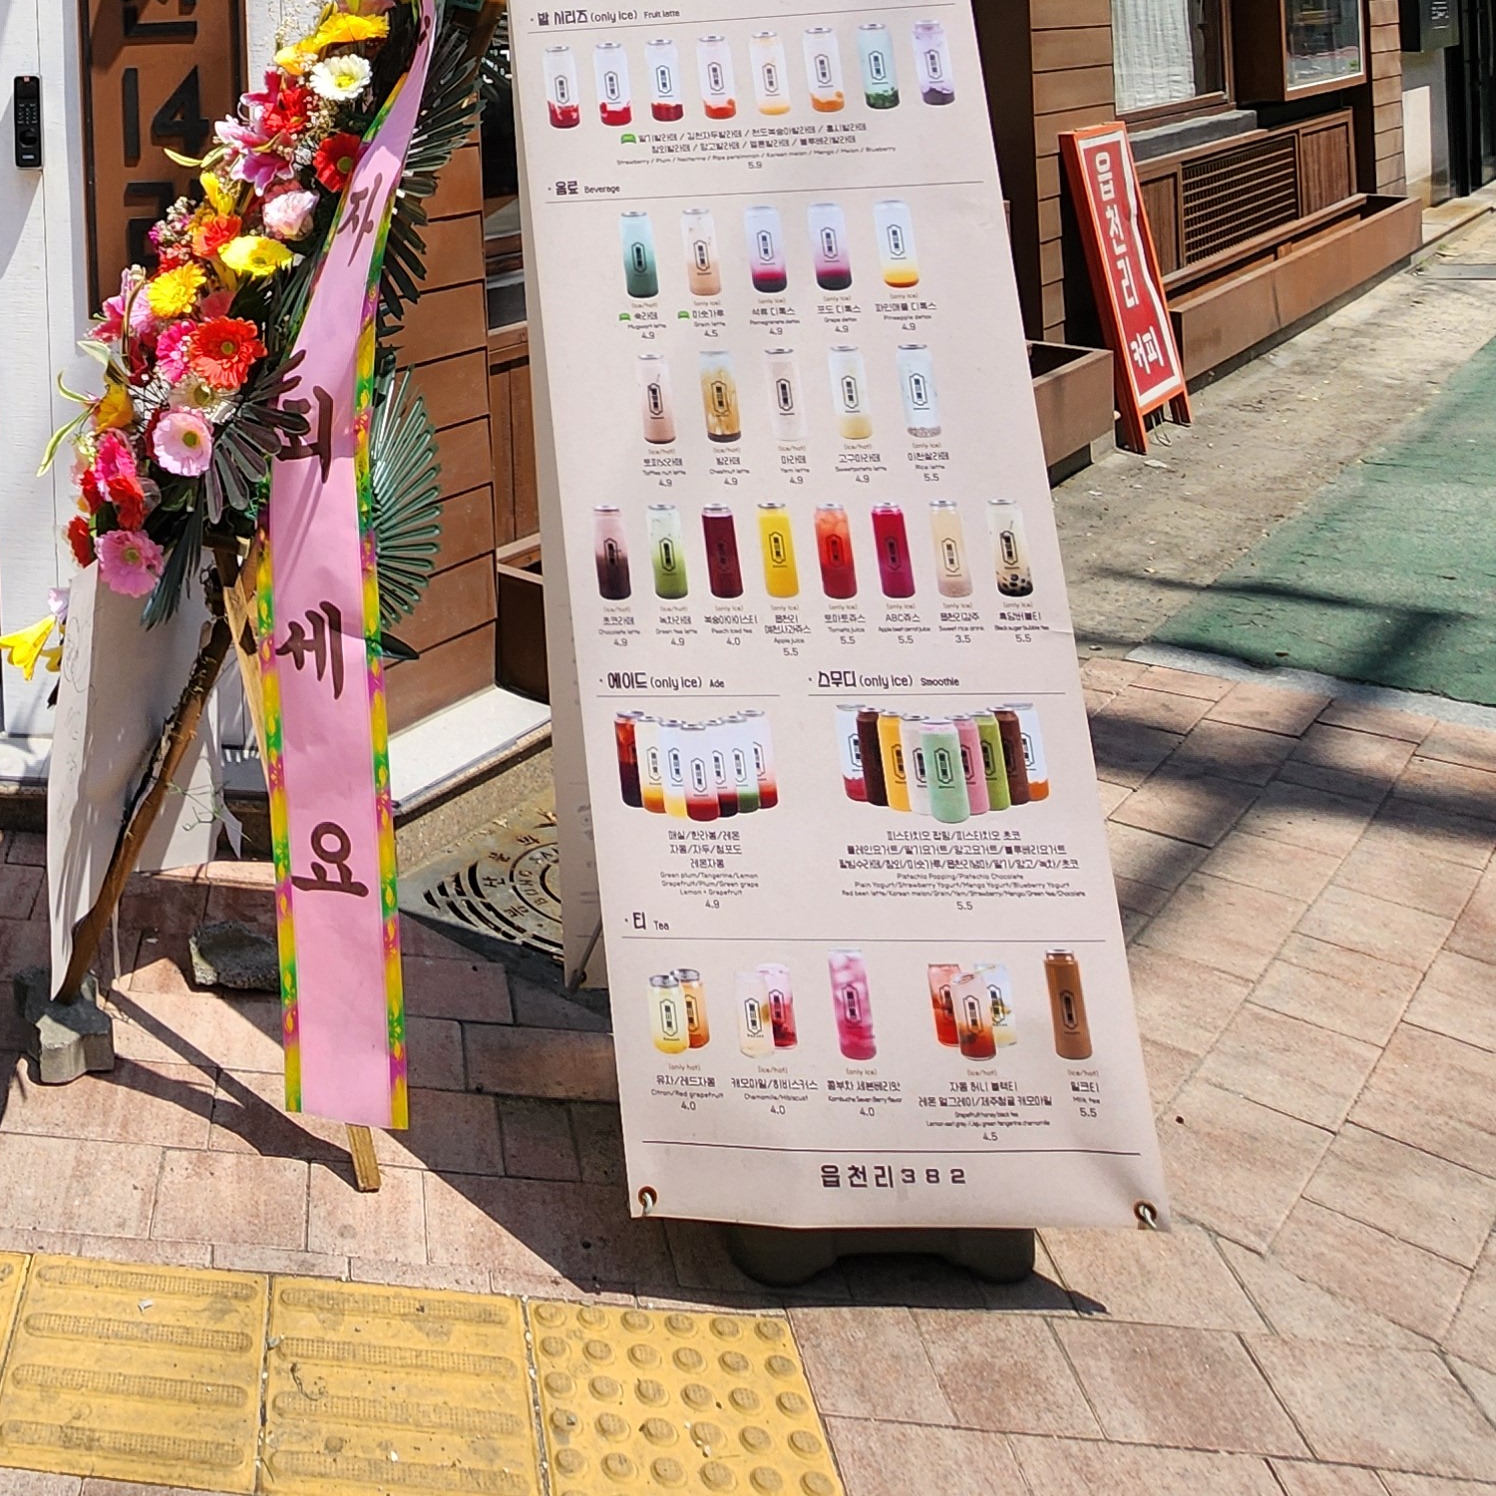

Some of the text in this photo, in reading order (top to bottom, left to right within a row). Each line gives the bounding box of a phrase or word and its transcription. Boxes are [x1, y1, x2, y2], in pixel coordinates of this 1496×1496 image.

[554, 10, 588, 25] 시리즈
[590, 13, 616, 23] (only
[555, 181, 620, 195] 음료 Beverage
[1095, 150, 1164, 375] 읍천리 커피
[924, 473, 939, 482] 5.5
[840, 636, 856, 645] 5.5
[898, 635, 914, 644] 5.5
[955, 635, 971, 644] 3.5
[1015, 634, 1032, 643] 5.5
[783, 648, 799, 656] 5.5
[607, 672, 648, 689] 에이드
[650, 676, 679, 690] (only
[709, 679, 725, 688] Ade
[818, 671, 856, 687] 스무디
[859, 675, 889, 689] (only
[920, 677, 959, 686] Smoothie
[956, 901, 973, 910] 5.5
[633, 912, 669, 930] 티 Tea
[681, 1101, 696, 1111] 4.0
[770, 1105, 786, 1115] 4.0
[860, 1107, 875, 1117] 4.0
[1079, 1108, 1097, 1117] 5.5
